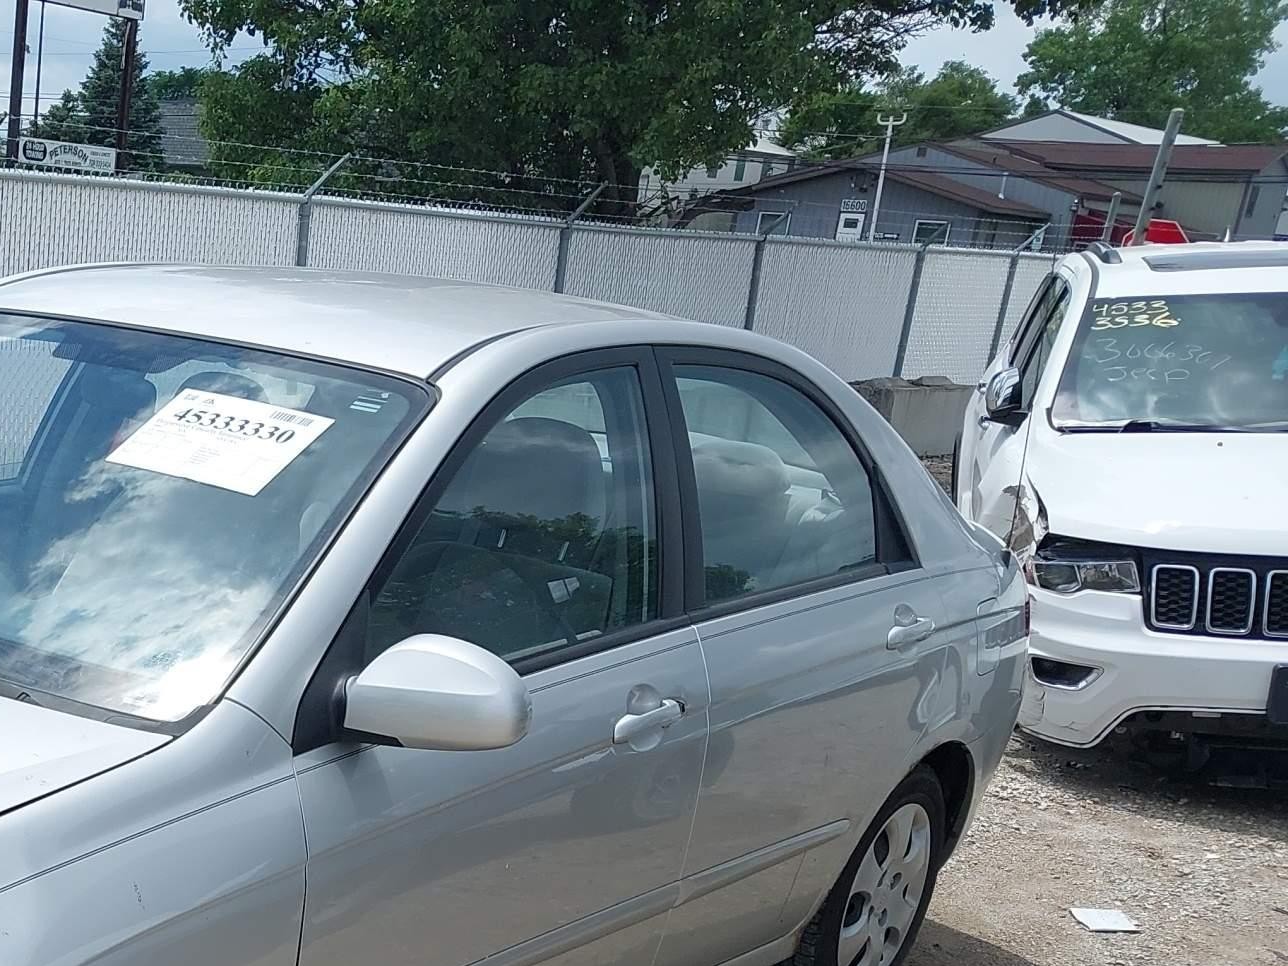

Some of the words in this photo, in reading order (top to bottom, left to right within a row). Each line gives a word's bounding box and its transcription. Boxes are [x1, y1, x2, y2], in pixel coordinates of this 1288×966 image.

[49, 145, 88, 164] PETERSON
[1092, 299, 1169, 316] 4533
[174, 406, 296, 445] 45333330
